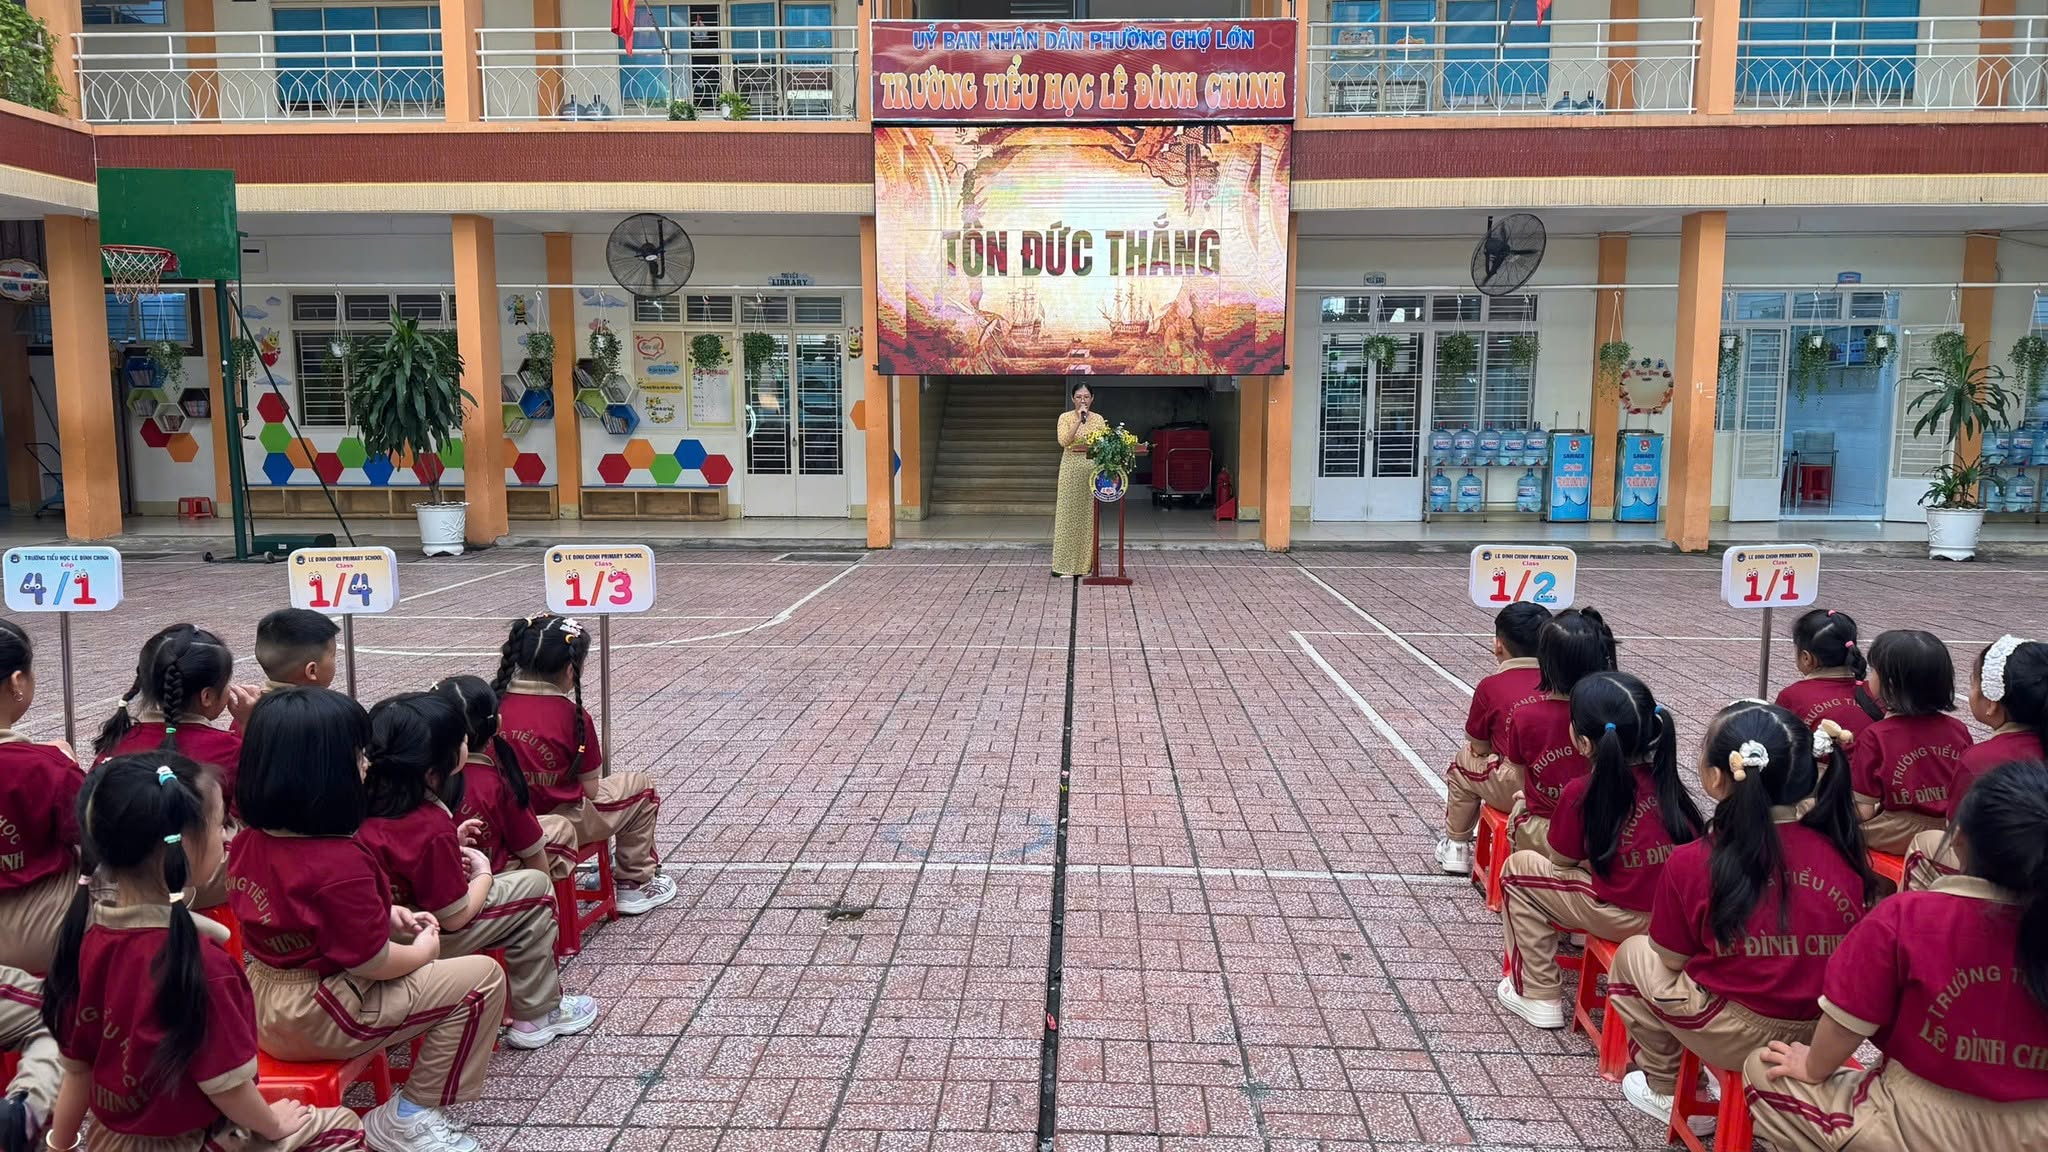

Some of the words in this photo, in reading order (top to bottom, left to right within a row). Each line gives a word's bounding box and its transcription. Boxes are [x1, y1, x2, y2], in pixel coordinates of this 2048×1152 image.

[943, 30, 982, 50] BAN
[987, 26, 1039, 50] NHÂN
[1044, 26, 1084, 50] DÂN
[1088, 26, 1166, 50] PHƯỜNG
[1171, 28, 1212, 53] CHỢ
[1216, 25, 1255, 50] LỚN
[880, 64, 978, 110] TRƯỜNG
[983, 54, 1040, 111] TIỂU
[1043, 72, 1095, 117] HỌC
[1099, 64, 1128, 110] LÊ
[1134, 64, 1199, 110] ĐÌNH
[1204, 72, 1287, 109] CHINH
[941, 222, 1008, 276] TÔN
[1020, 221, 1093, 276] ĐỨC
[1105, 212, 1221, 276] THẮNG
[771, 279, 808, 287] LIBRARY
[20, 571, 97, 605] 4/1
[308, 573, 373, 607] 1/4
[566, 571, 633, 606] 1/3
[1490, 569, 1557, 602] 1/2
[1744, 569, 1799, 601] 1/1
[1803, 698, 1841, 727] RƯỜNG
[537, 743, 556, 769] HỌC
[1892, 747, 1928, 786] TRƯỜNG
[1930, 744, 1960, 760] TIỂU
[1892, 788, 1913, 804] LÊ
[1915, 784, 1948, 803] ĐÌNH
[1622, 796, 1657, 847] TRƯỜNG
[1622, 849, 1643, 869] LÊ
[1647, 840, 1675, 865] ĐÌN
[247, 881, 270, 912] TIỂU
[1828, 886, 1855, 924] HỌC
[1744, 929, 1799, 957] ĐÌNH
[1805, 934, 1844, 956] CHI
[1928, 965, 2001, 1019] TRƯỜNG
[1919, 1018, 1948, 1053] LÊ
[1954, 1028, 2006, 1065] ĐÌNH
